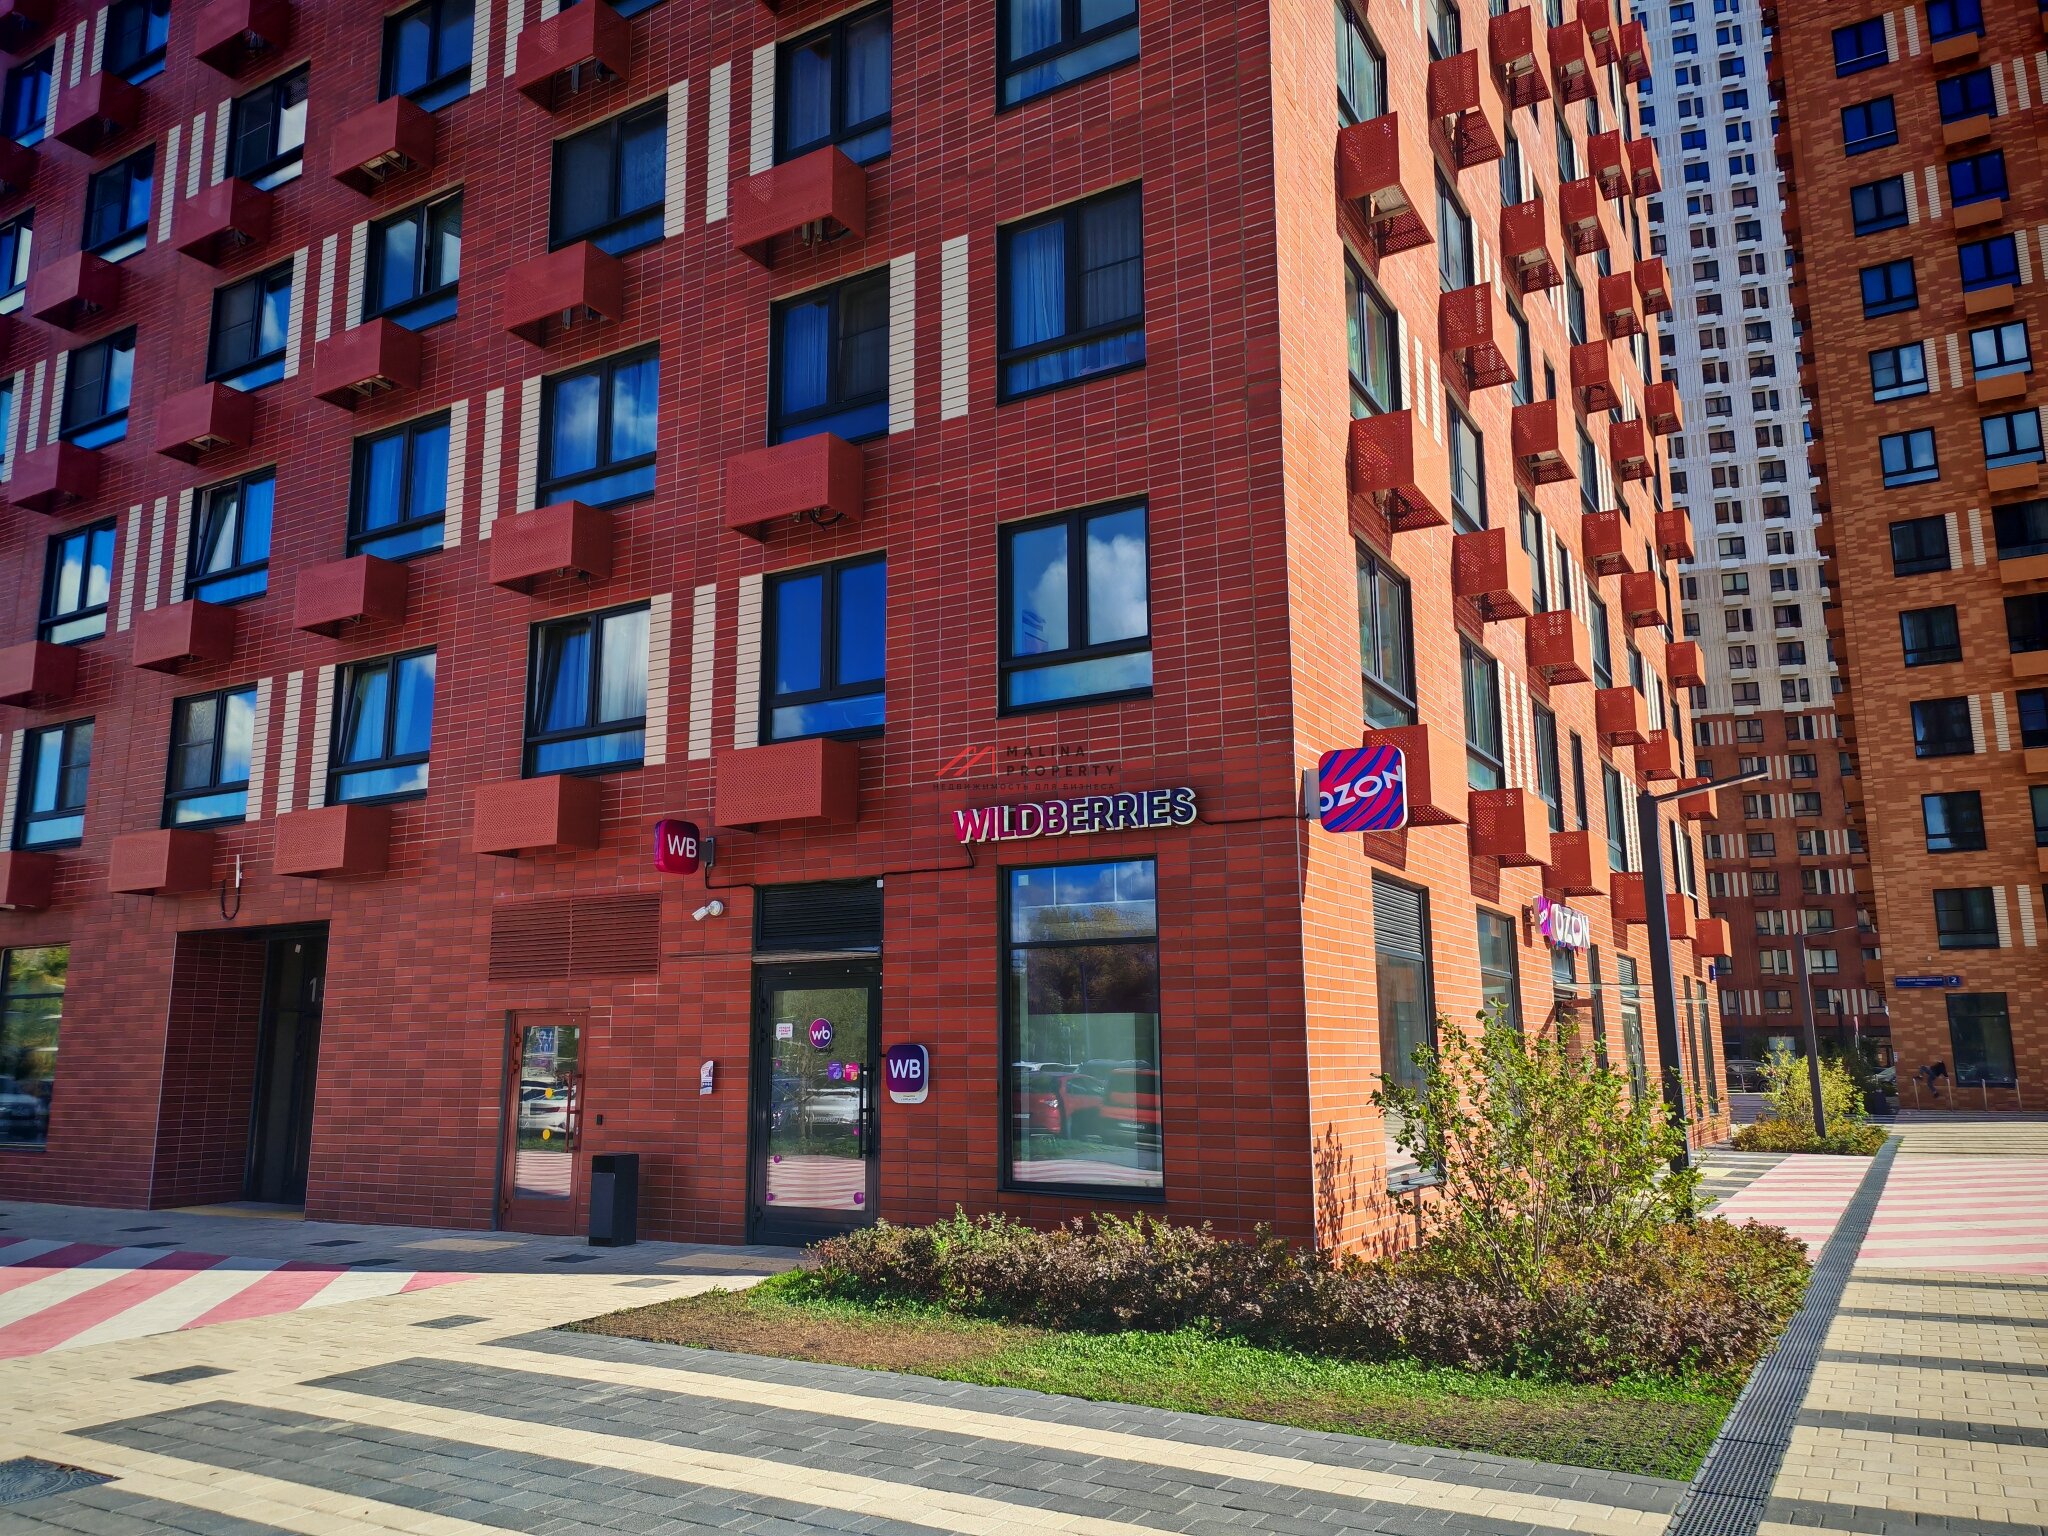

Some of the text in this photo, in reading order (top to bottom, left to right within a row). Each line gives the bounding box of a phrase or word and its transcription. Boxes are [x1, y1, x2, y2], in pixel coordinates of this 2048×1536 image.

[953, 788, 1196, 843] WILDBERRIES
[667, 834, 697, 857] WB
[1551, 904, 1590, 948] OZON
[812, 1026, 831, 1041] wb
[889, 1058, 921, 1079] WB
